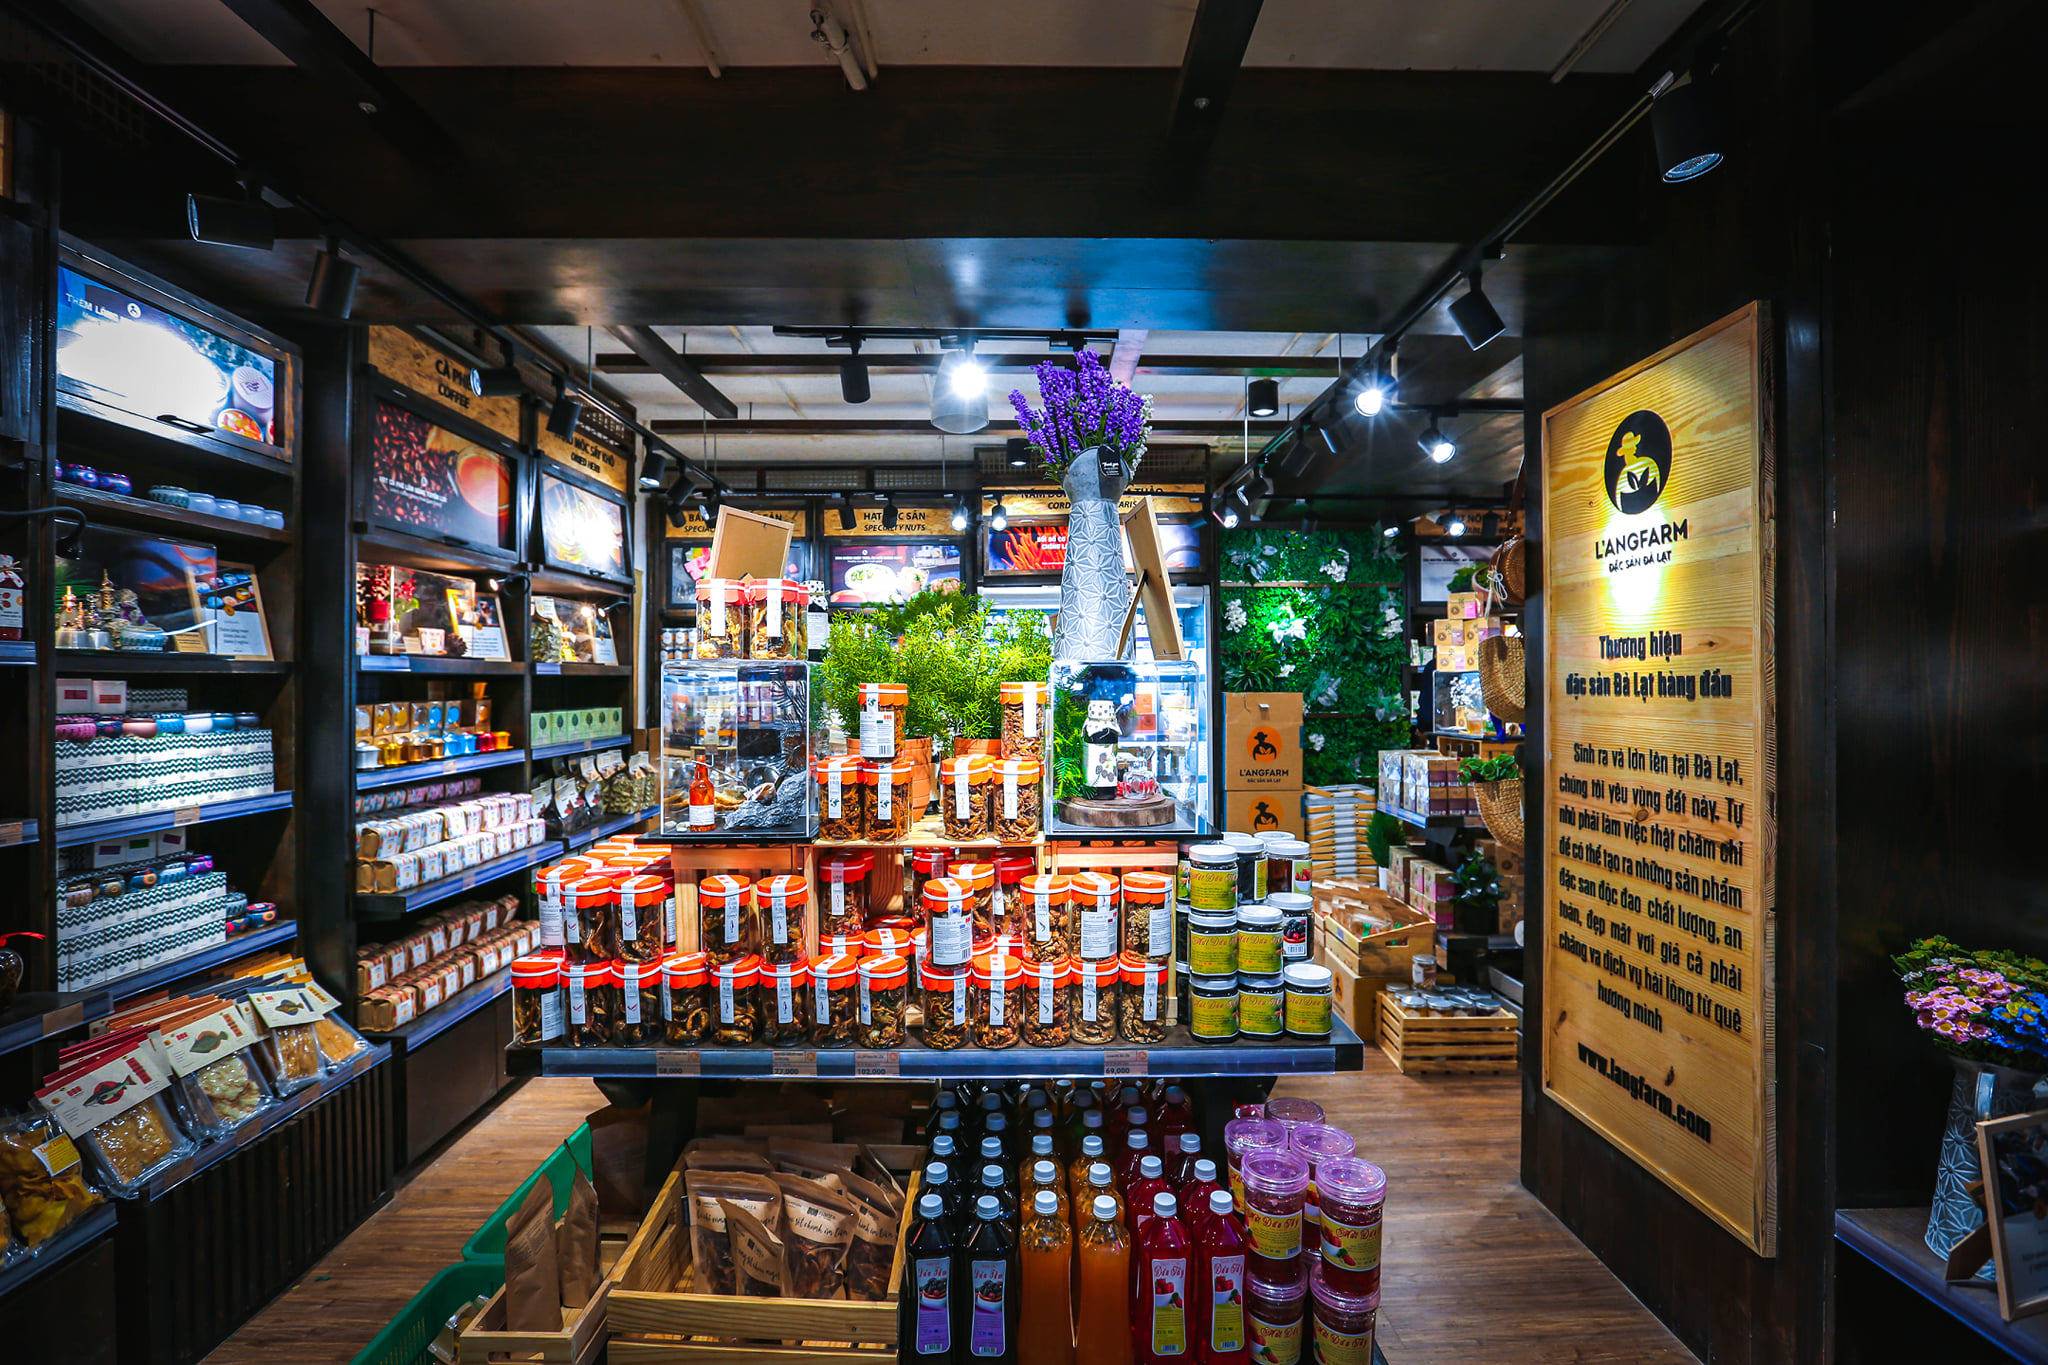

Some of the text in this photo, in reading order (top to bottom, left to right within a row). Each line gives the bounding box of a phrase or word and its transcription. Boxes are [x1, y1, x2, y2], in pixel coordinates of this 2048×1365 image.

[438, 383, 470, 409] COFFEE
[864, 512, 882, 523] HẠT
[906, 510, 926, 520] SẢN
[905, 524, 926, 532] NUTS
[1595, 518, 1689, 560] L'ANGFARM
[1599, 630, 1682, 662] Thương hiệu
[1566, 668, 1732, 703] đặc sản Đà Lạt hàng đầu
[1240, 768, 1289, 777] L'ANGFARM
[1574, 742, 1595, 764] Sinh
[1598, 748, 1608, 767] ra
[1649, 749, 1668, 775] lên
[1673, 753, 1689, 781] tại
[1693, 753, 1712, 780] Đà
[1717, 755, 1744, 786] Lạt,
[1559, 773, 1588, 799] chúng
[1591, 779, 1605, 799] tôi
[1608, 782, 1628, 804] yêu
[1665, 788, 1687, 815] đất
[1725, 797, 1744, 829] Tự
[1601, 812, 1621, 837] làm
[1624, 819, 1648, 845] việc
[1651, 823, 1675, 852] thật
[1603, 849, 1620, 873] tạo
[1622, 856, 1634, 876] ra
[1635, 857, 1673, 890] những
[1559, 867, 1577, 892] đặc
[1598, 879, 1618, 906] độc
[1647, 897, 1675, 926] chất
[1678, 905, 1721, 945] lượng,
[1724, 925, 1743, 951] an
[1586, 909, 1606, 936] đẹp
[1597, 979, 1631, 1019] hương
[1602, 949, 1626, 976] dịch
[1628, 964, 1642, 990] vụ
[1666, 976, 1693, 1014] lòng
[1577, 1042, 1712, 1144] www.langfarm.com
